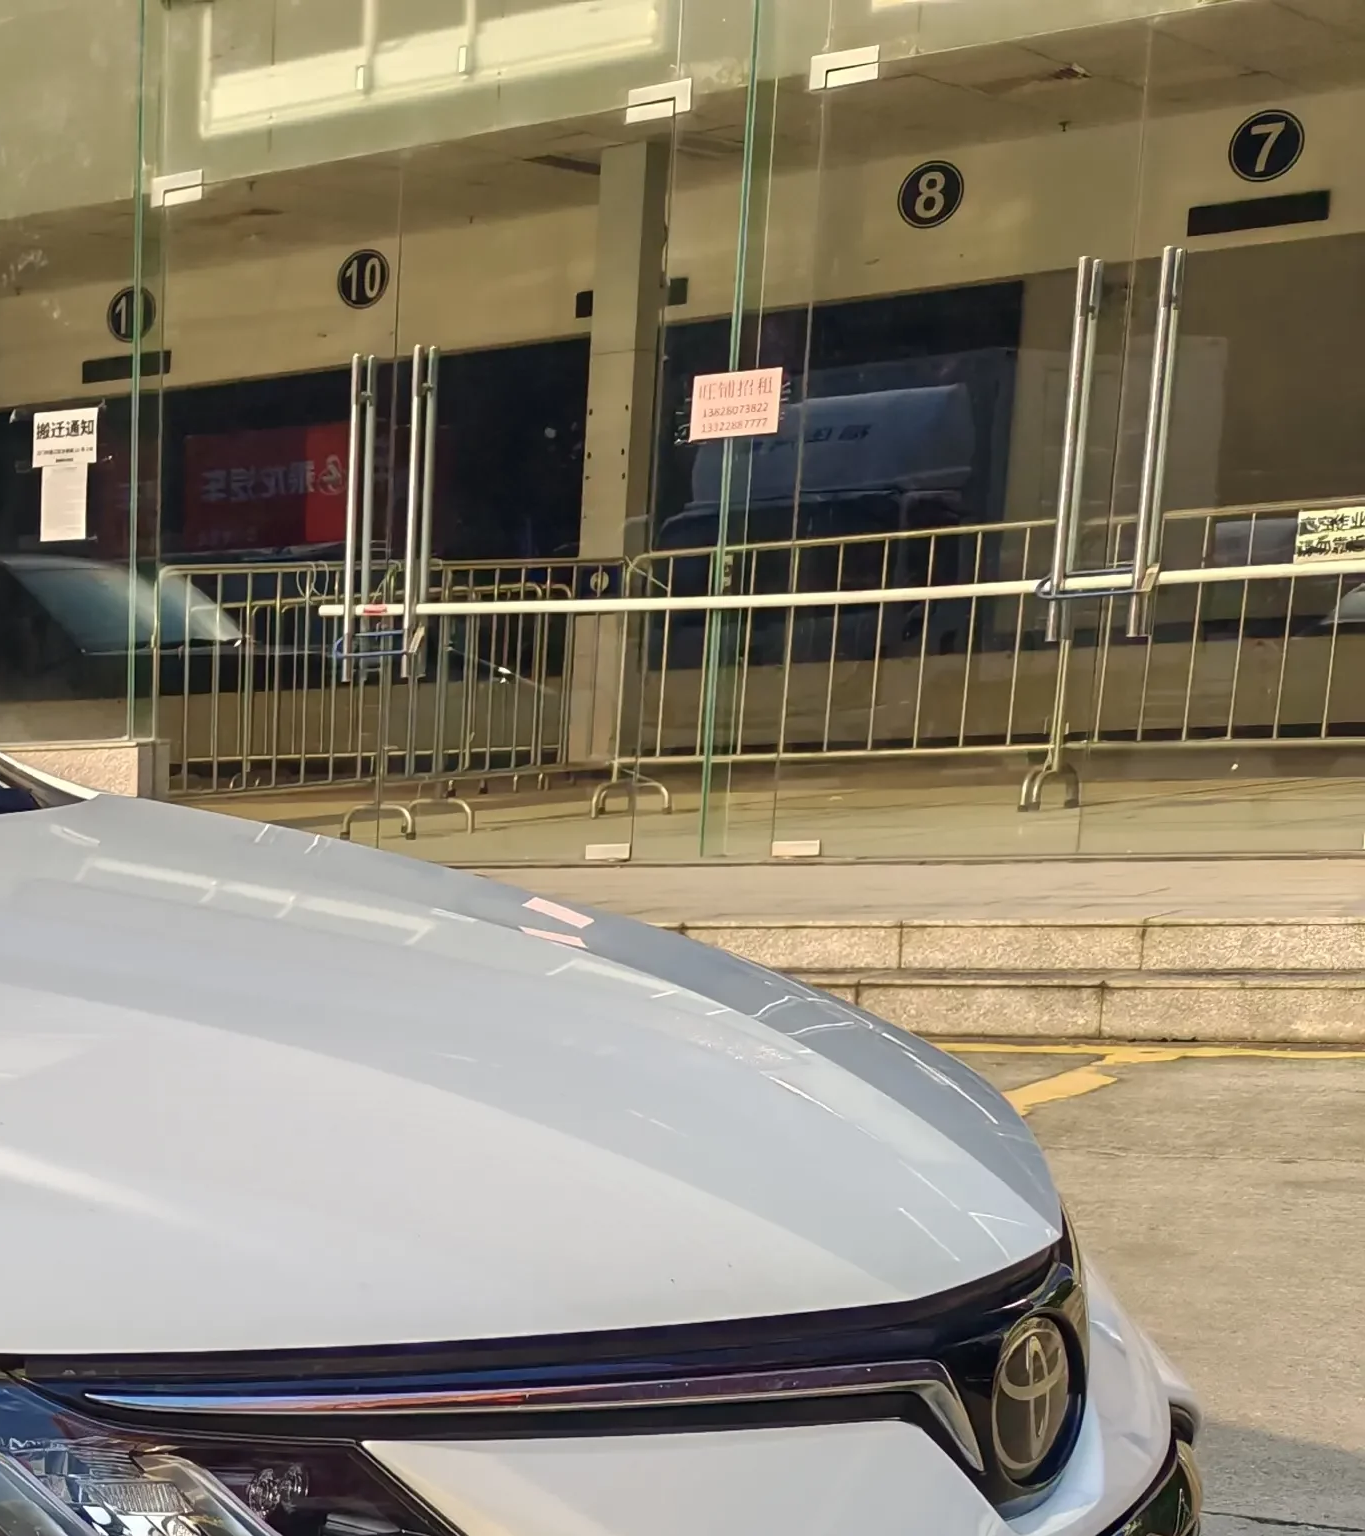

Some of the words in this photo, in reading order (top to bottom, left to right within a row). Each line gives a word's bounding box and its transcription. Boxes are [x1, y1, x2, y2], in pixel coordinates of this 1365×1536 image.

[1251, 121, 1286, 173] 7
[914, 171, 946, 219] 8
[345, 257, 381, 301] 10
[698, 376, 774, 401] 旺铺招租
[35, 419, 95, 440] 搬迁通知
